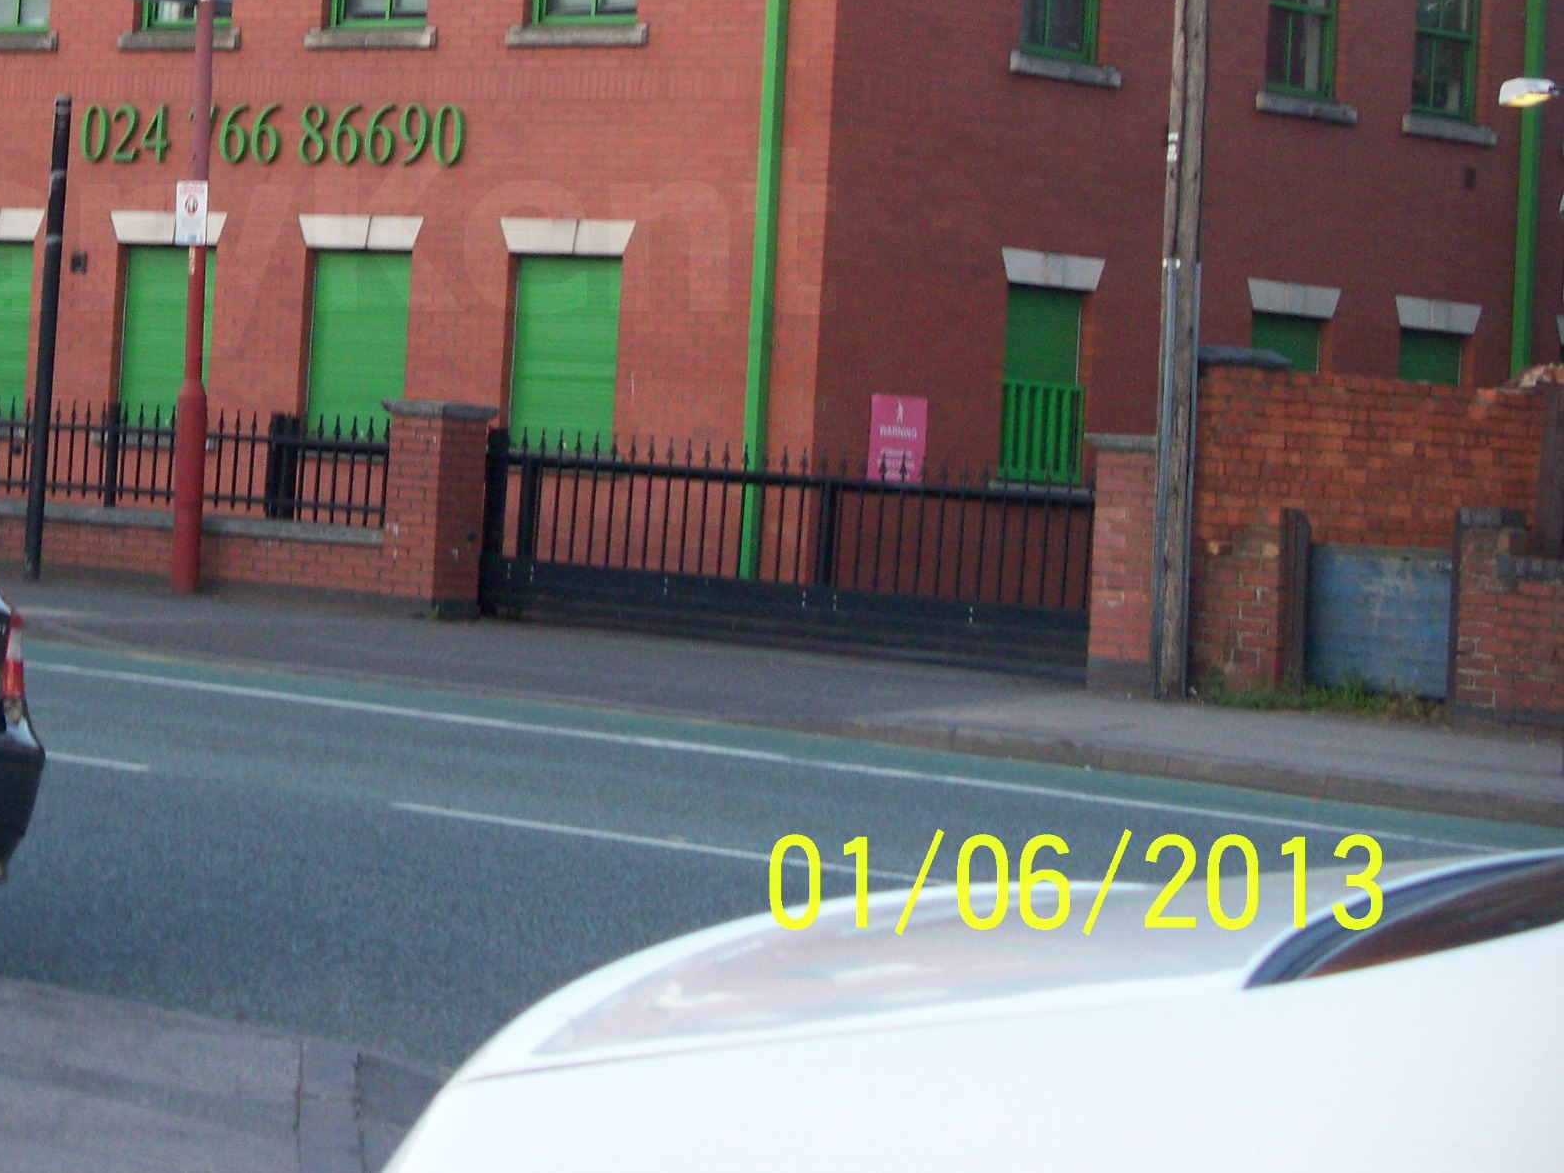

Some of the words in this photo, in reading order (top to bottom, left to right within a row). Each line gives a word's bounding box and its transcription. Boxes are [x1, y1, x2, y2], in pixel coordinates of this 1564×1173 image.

[79, 103, 169, 164] 024
[297, 102, 468, 167] 86690
[879, 424, 918, 440] WARNING
